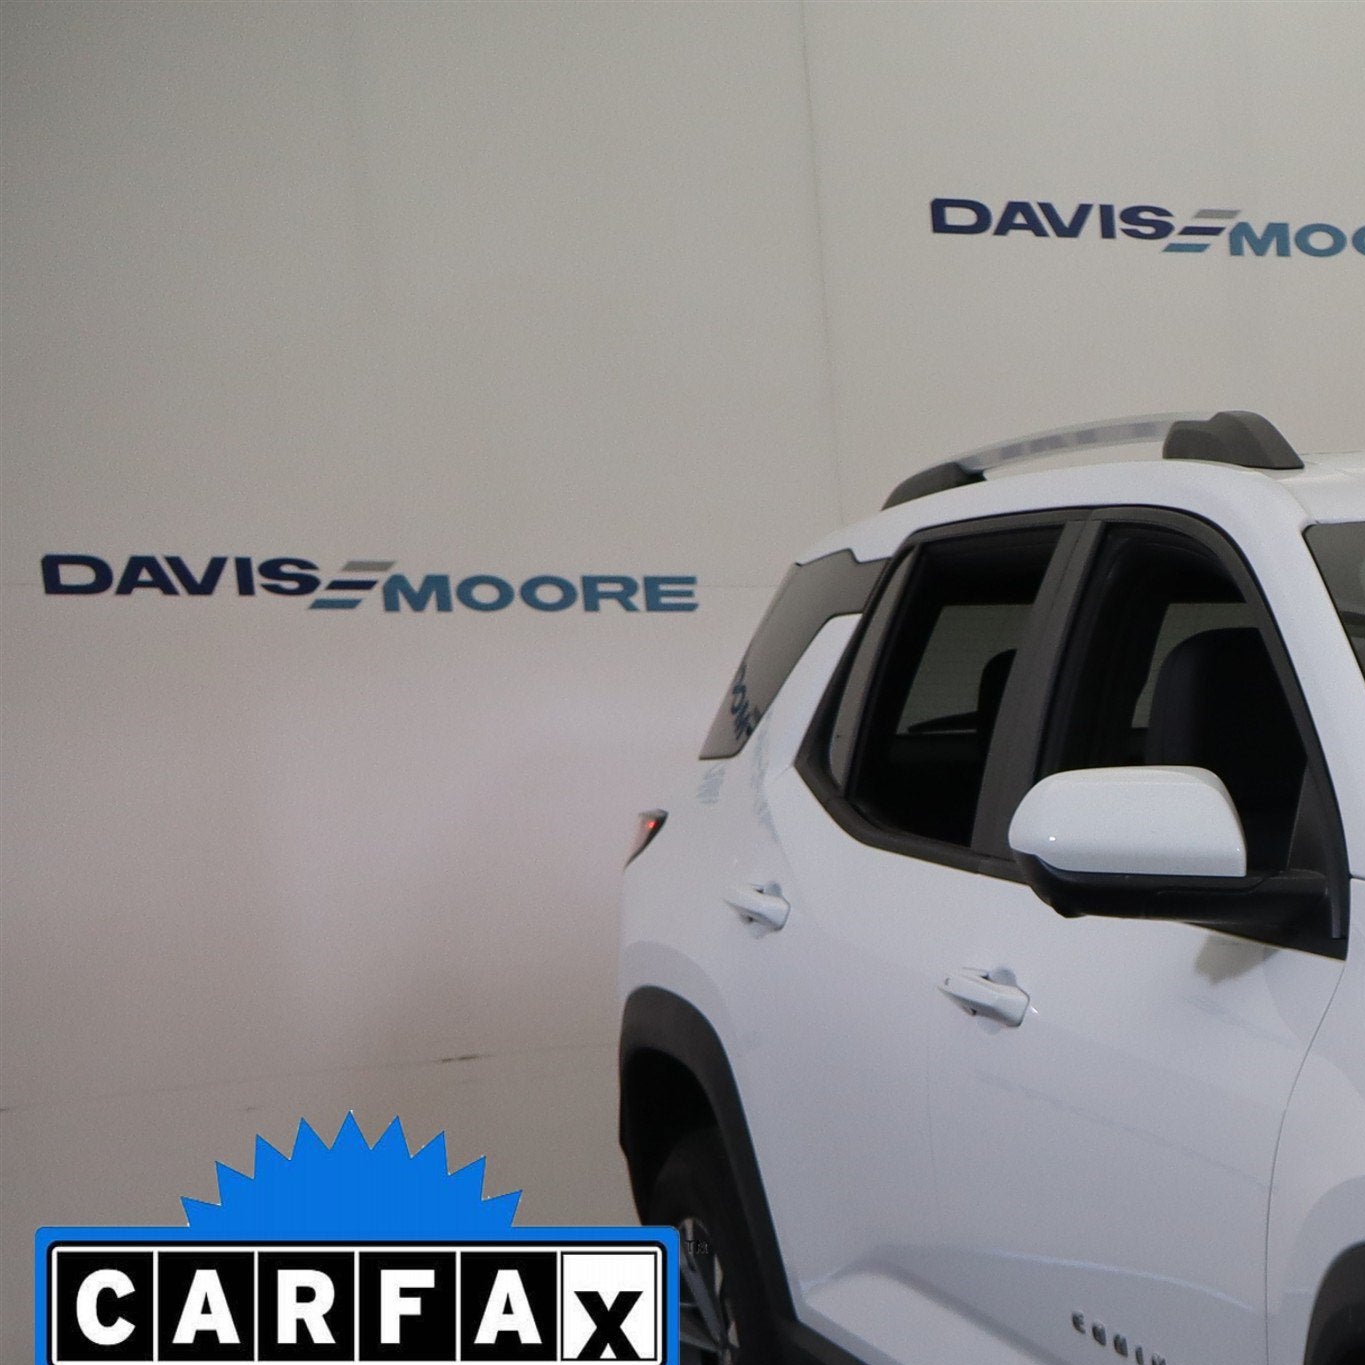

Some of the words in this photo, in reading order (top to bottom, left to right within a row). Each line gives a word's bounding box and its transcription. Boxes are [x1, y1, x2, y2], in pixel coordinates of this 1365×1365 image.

[931, 198, 1173, 239] DAVIS
[41, 554, 321, 596] DAVIS
[382, 574, 699, 612] MOORE
